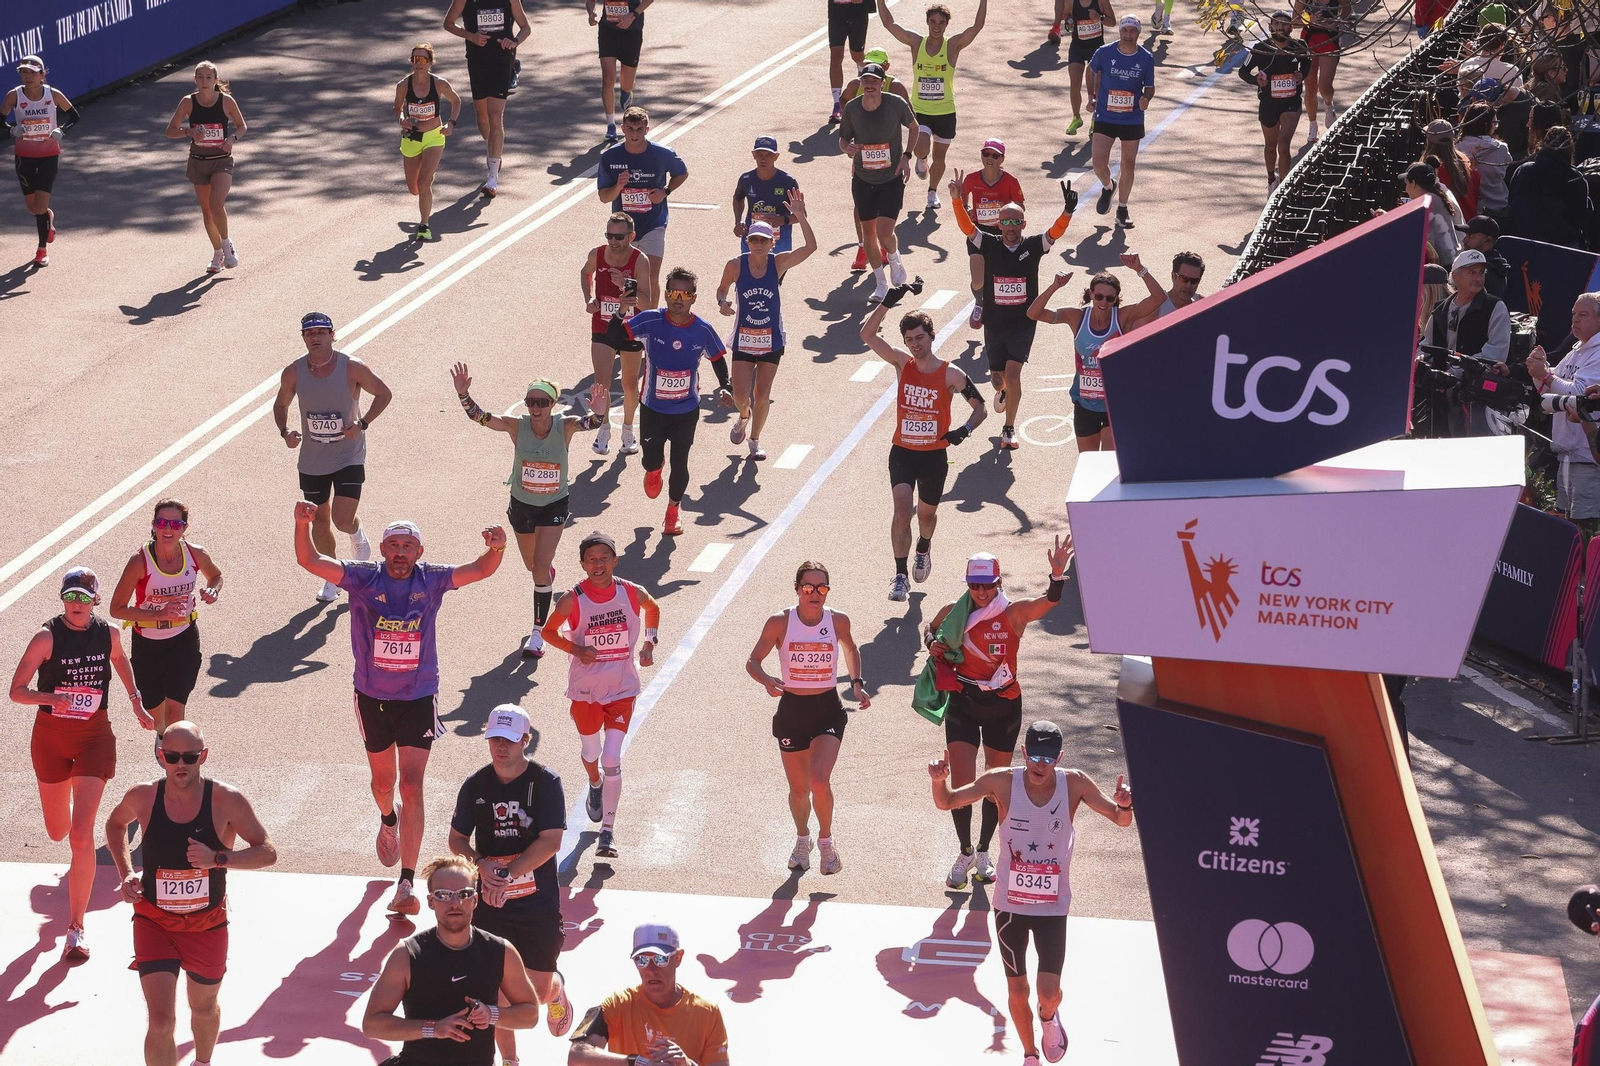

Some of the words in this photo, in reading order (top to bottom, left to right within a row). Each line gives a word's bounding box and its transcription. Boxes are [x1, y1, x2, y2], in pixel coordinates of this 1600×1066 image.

[56, 16, 76, 44] THE
[77, 4, 104, 38] RUDIN
[480, 13, 502, 23] 19803
[1110, 68, 1140, 78] EMANUELE
[25, 108, 48, 116] MAKIE
[420, 105, 434, 113] 3081
[865, 150, 886, 158] 9695
[624, 193, 648, 202] 39137
[742, 288, 774, 299] BOSTON
[999, 284, 1022, 293] 4256
[661, 378, 686, 388] 7920
[1212, 334, 1352, 426] tcs
[904, 383, 938, 400] FRED'S
[905, 395, 934, 408] TEAM
[312, 421, 337, 430] 6740
[904, 421, 934, 432] 12582
[524, 469, 534, 477] AG
[1261, 561, 1301, 586] tcs
[1502, 562, 1534, 587] FAMILY
[1260, 592, 1298, 609] NEW
[1304, 595, 1350, 612] YORK
[1355, 599, 1393, 615] CITY
[606, 609, 623, 618] YORK
[1258, 609, 1359, 630] MARATHON
[375, 615, 421, 632] BERLIN
[592, 633, 621, 646] 1067
[382, 642, 412, 654] 7614
[790, 653, 804, 662] AG
[807, 653, 831, 662] 3249
[71, 694, 92, 707] 198
[1198, 850, 1286, 876] Citizens
[162, 879, 203, 895] 12167
[1016, 874, 1051, 890] 6345
[1228, 973, 1309, 990] mastercard
